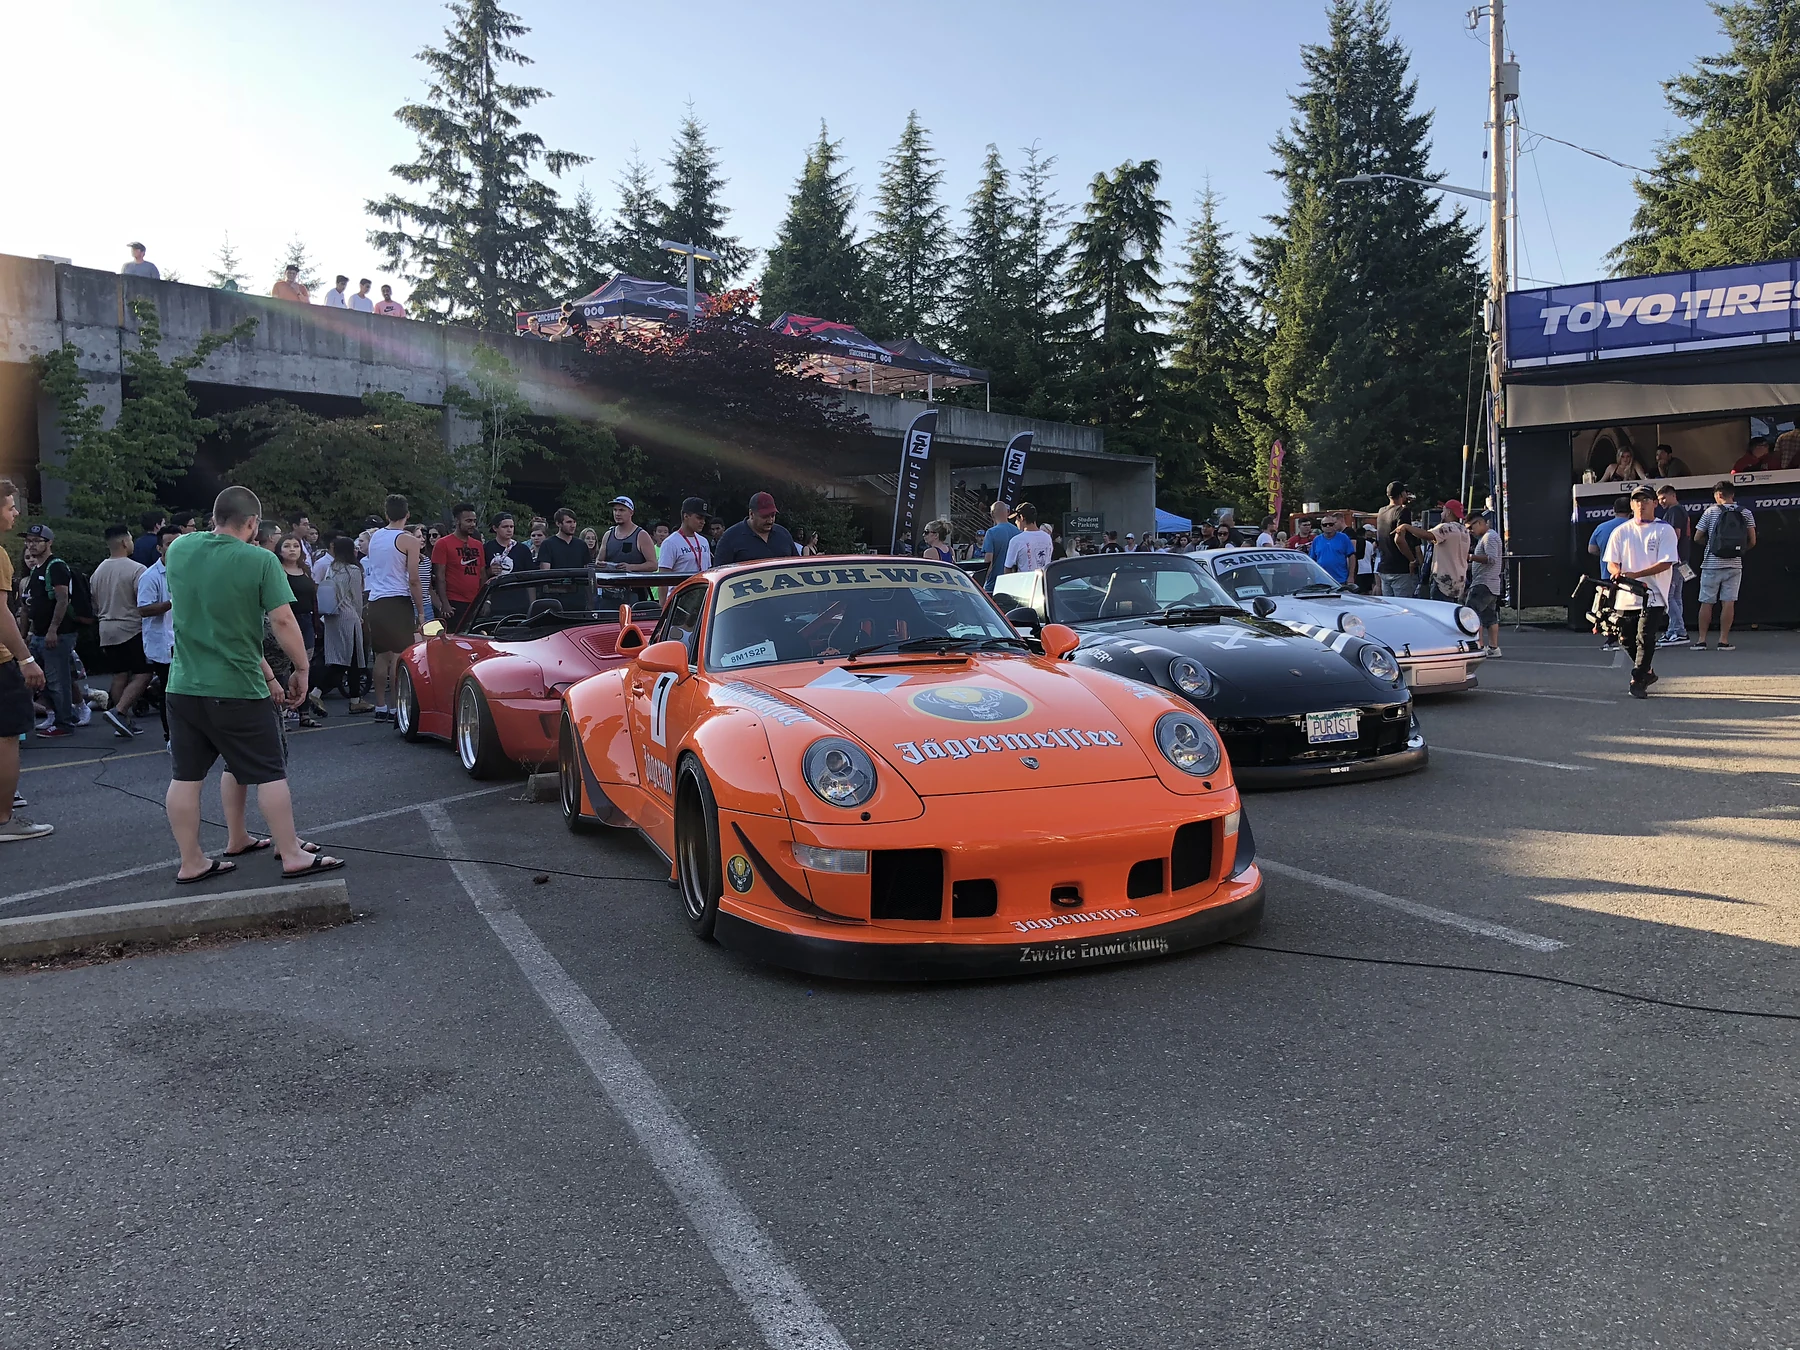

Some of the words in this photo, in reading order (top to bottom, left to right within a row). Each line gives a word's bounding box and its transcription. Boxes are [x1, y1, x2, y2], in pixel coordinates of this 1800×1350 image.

[1539, 293, 1676, 336] TOYO
[1680, 280, 1800, 321] TIRE
[1755, 497, 1791, 508] TOYO
[729, 567, 971, 599] RAUH-Welt
[730, 646, 766, 663] 8M1S2P
[1313, 717, 1352, 735] PURIST
[1019, 945, 1076, 962] Zweite
